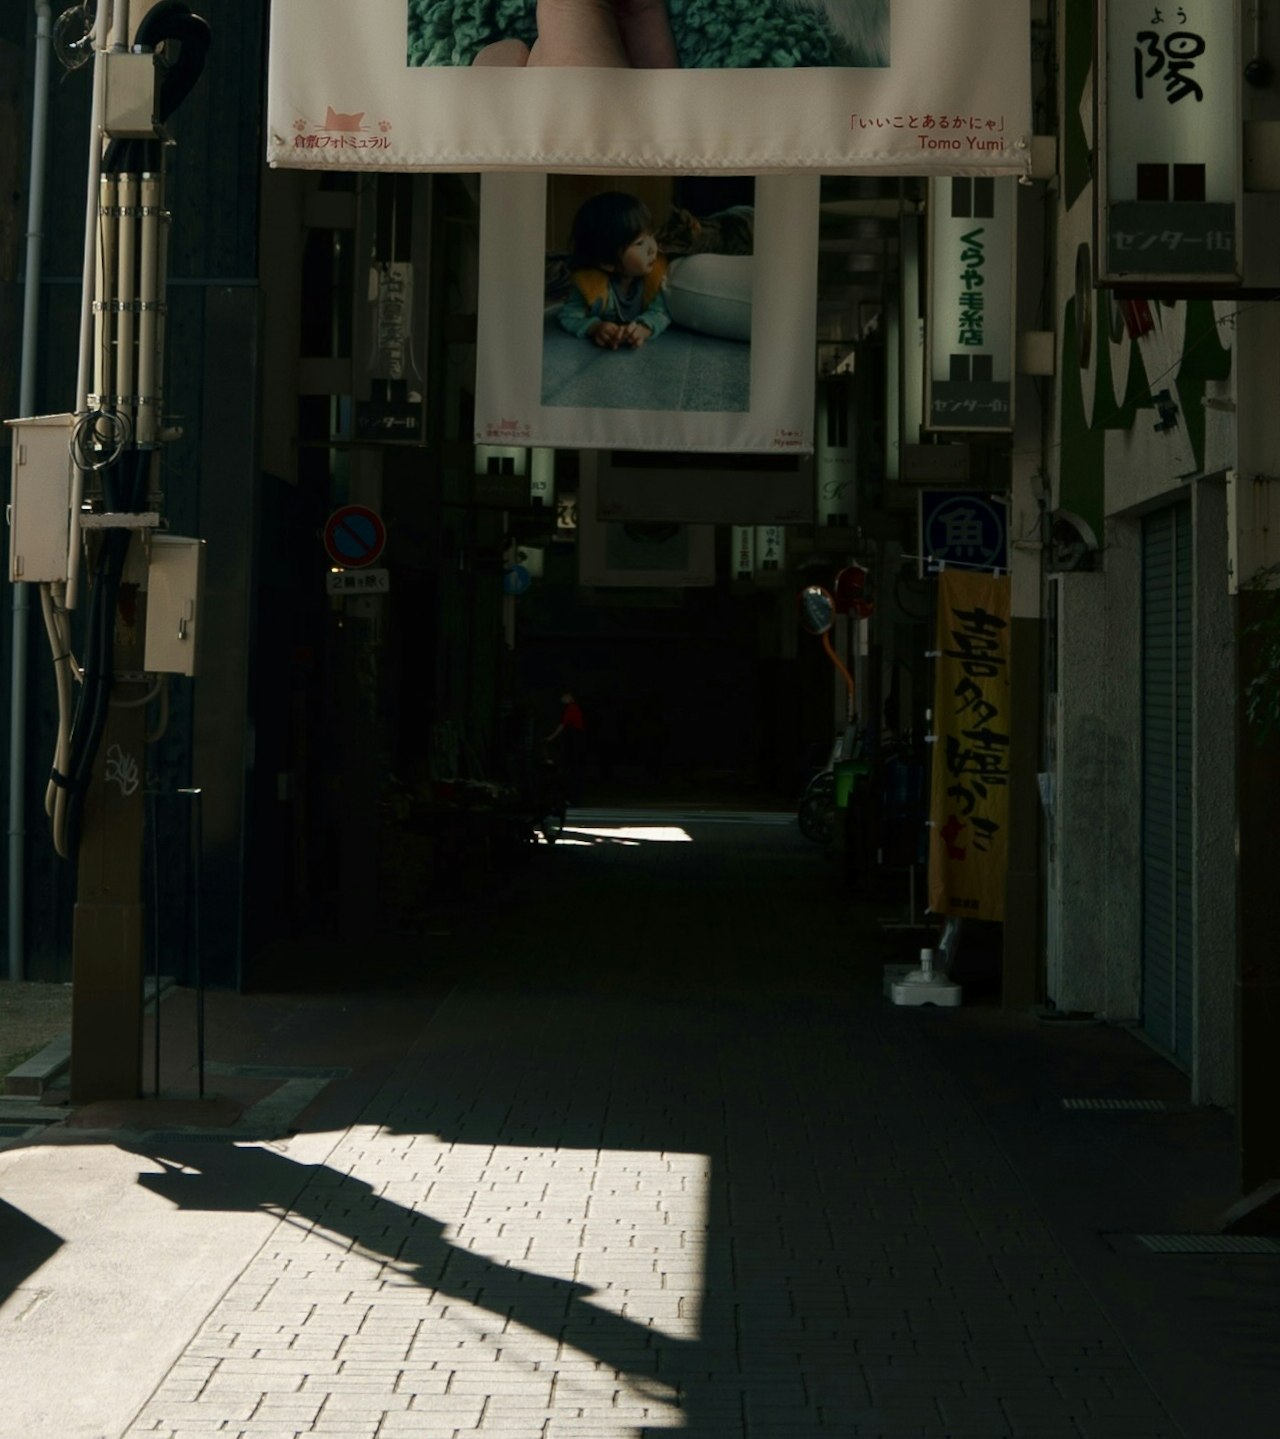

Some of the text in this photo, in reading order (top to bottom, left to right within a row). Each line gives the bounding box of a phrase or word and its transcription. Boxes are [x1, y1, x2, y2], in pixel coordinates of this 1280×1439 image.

[1150, 5, 1189, 26] よう
[1134, 29, 1207, 104] 陽
[850, 114, 1006, 132] 「いいことあるかにゃ」
[293, 134, 392, 150] 倉敷フォトミュラル
[917, 134, 1005, 152] Tomo Yumi
[1111, 229, 1234, 253] センター街
[958, 226, 986, 347] くらや毛糸店
